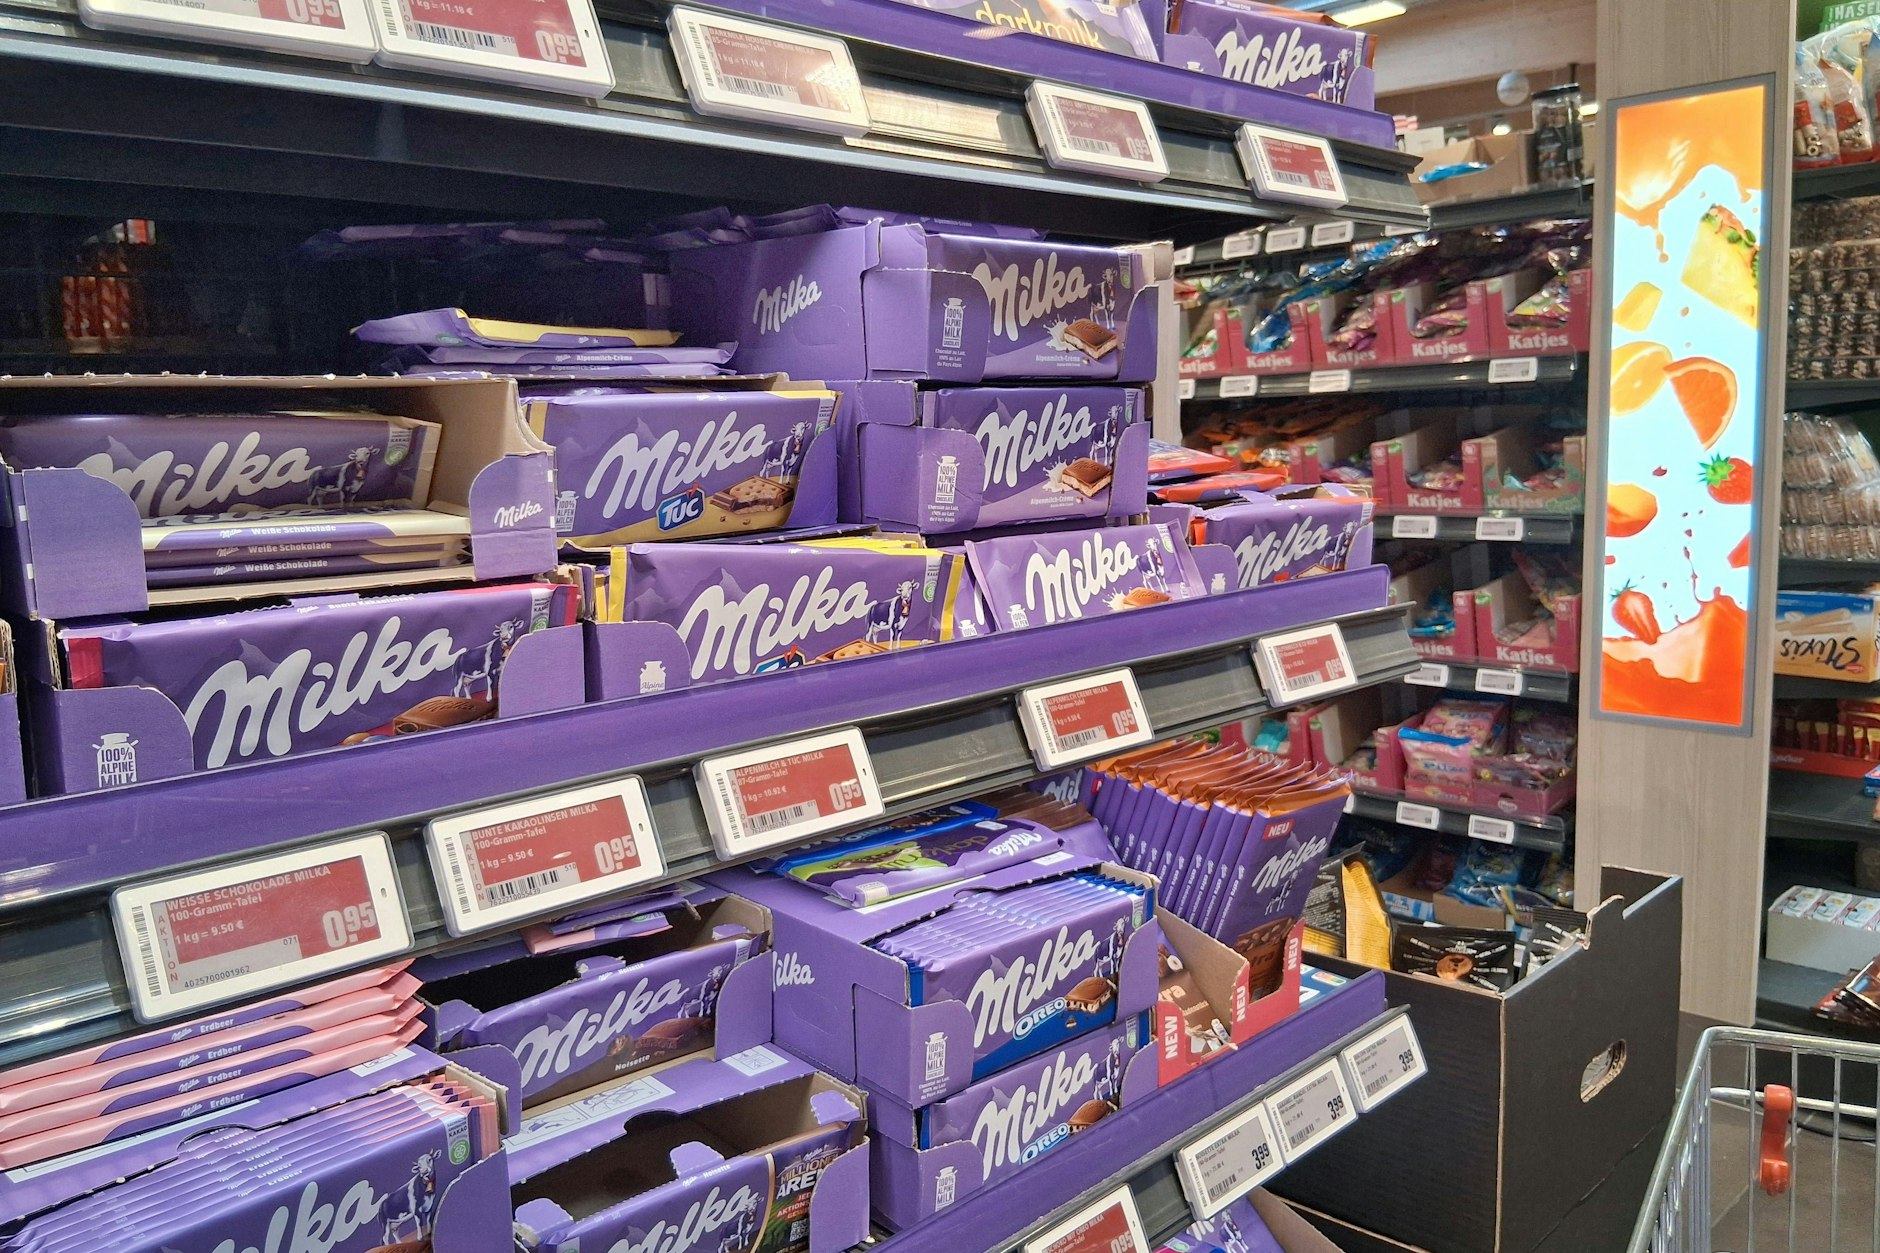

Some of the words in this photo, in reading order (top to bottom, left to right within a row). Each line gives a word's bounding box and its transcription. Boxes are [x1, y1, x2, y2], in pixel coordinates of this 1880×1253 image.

[417, 0, 430, 10] kg
[441, 3, 465, 14] 11.18
[467, 7, 474, 16] €
[535, 29, 582, 64] 0.95
[1215, 27, 1327, 89] Milka
[723, 55, 734, 67] kg
[1125, 137, 1151, 160] 0.95
[753, 274, 822, 335] Milka
[972, 251, 1092, 342] Milka
[944, 327, 961, 338] MILK
[1509, 331, 1569, 353] Katjes
[576, 354, 633, 362] Alpenmilch-Crème
[1035, 354, 1081, 363] Alpenmilch-Crème
[1246, 352, 1293, 371] Katjes
[1326, 347, 1376, 366] Katjes
[1412, 339, 1468, 360] Katjes
[975, 393, 1097, 492] Milka
[80, 432, 324, 516] Milka
[584, 410, 773, 518] Milka
[662, 496, 700, 524] TUC
[1407, 491, 1462, 511] Katjes
[1486, 491, 1545, 511] Katjes
[493, 502, 544, 529] Milka
[219, 527, 243, 539] Milka
[251, 525, 282, 536] Weiße
[283, 523, 337, 535] Schokolade
[216, 546, 240, 557] Milka
[248, 543, 279, 553] Weiße
[280, 540, 332, 552] Schokolade
[1233, 516, 1333, 588] Milka
[213, 565, 236, 576] Milka
[245, 561, 276, 572] Weiße
[276, 558, 328, 571] Schokolade
[1025, 533, 1140, 622] Milka
[328, 601, 357, 609] Bunte
[358, 595, 415, 608] Kakaolinsen
[678, 566, 877, 680] Milka
[1412, 641, 1454, 658] atjes
[1496, 643, 1556, 667] Katjes
[1779, 636, 1861, 671] Stixis
[185, 615, 467, 768] Milka
[641, 681, 666, 692] Alpine
[1093, 685, 1109, 696] MILKA
[1112, 709, 1136, 735] 0.95
[101, 747, 132, 762] 100%
[736, 761, 780, 778] ALPENMILCH
[780, 760, 787, 768] &
[787, 756, 801, 767] TUC
[802, 751, 824, 763] MILKA
[101, 761, 134, 775] ALPINE
[737, 769, 789, 786] 87-Gramm-Tafel
[747, 792, 758, 803] kg
[763, 787, 782, 799] 10.92
[782, 785, 787, 793] €
[828, 778, 862, 812] 0.95
[472, 826, 503, 841] BUNTE
[504, 810, 568, 833] KAKAOLINSEN
[570, 803, 599, 818] MILKA
[1268, 822, 1289, 837] NEU
[475, 826, 547, 850] 100-Gramm-Tafel
[989, 832, 1043, 857] Milka
[486, 857, 499, 870] kg
[508, 850, 527, 862] 9.50
[527, 848, 534, 858] €
[594, 835, 637, 874] 0.95
[1251, 835, 1328, 893] Milka
[167, 892, 212, 912] WEISSE
[213, 875, 292, 900] SCHOKOLADE
[294, 865, 331, 882] MILKA
[170, 894, 263, 923] 100-Gramm-Tafel
[175, 935, 181, 945] 1
[183, 931, 200, 946] kg
[212, 922, 235, 937] 9.50
[236, 919, 245, 931] €
[322, 901, 377, 948] 0.95
[283, 936, 298, 946] 071
[1288, 937, 1299, 971] NEU
[184, 965, 250, 988] 4025700001962
[772, 951, 815, 992] ilka
[966, 926, 1100, 1048] Milka
[1236, 985, 1246, 1022] NEU
[171, 1027, 193, 1042] Milka
[200, 1017, 234, 1034] Erdbeer
[1014, 997, 1066, 1038] OREO
[513, 977, 690, 1088] Milka
[1165, 1016, 1178, 1059] NEW
[178, 1054, 200, 1069] Milka
[208, 1044, 242, 1060] Erdbeer
[615, 1054, 651, 1071] Noisette
[927, 1059, 943, 1071] MILK
[1399, 1048, 1414, 1072] 3.99
[178, 1078, 200, 1093] Milka
[207, 1068, 242, 1085] Erdbeer
[180, 1103, 203, 1118] Milka
[210, 1092, 245, 1108] Erdbeer
[971, 1050, 1097, 1181] Milka
[1327, 1095, 1344, 1120] 3.99
[449, 1126, 467, 1137] KAKAO
[1021, 1123, 1069, 1164] OREO
[1251, 1142, 1270, 1170] 3.99
[703, 1164, 731, 1179] Noisette
[209, 1180, 389, 1253] lka
[1076, 1223, 1089, 1236] OREO
[1088, 1214, 1105, 1229] MILKA
